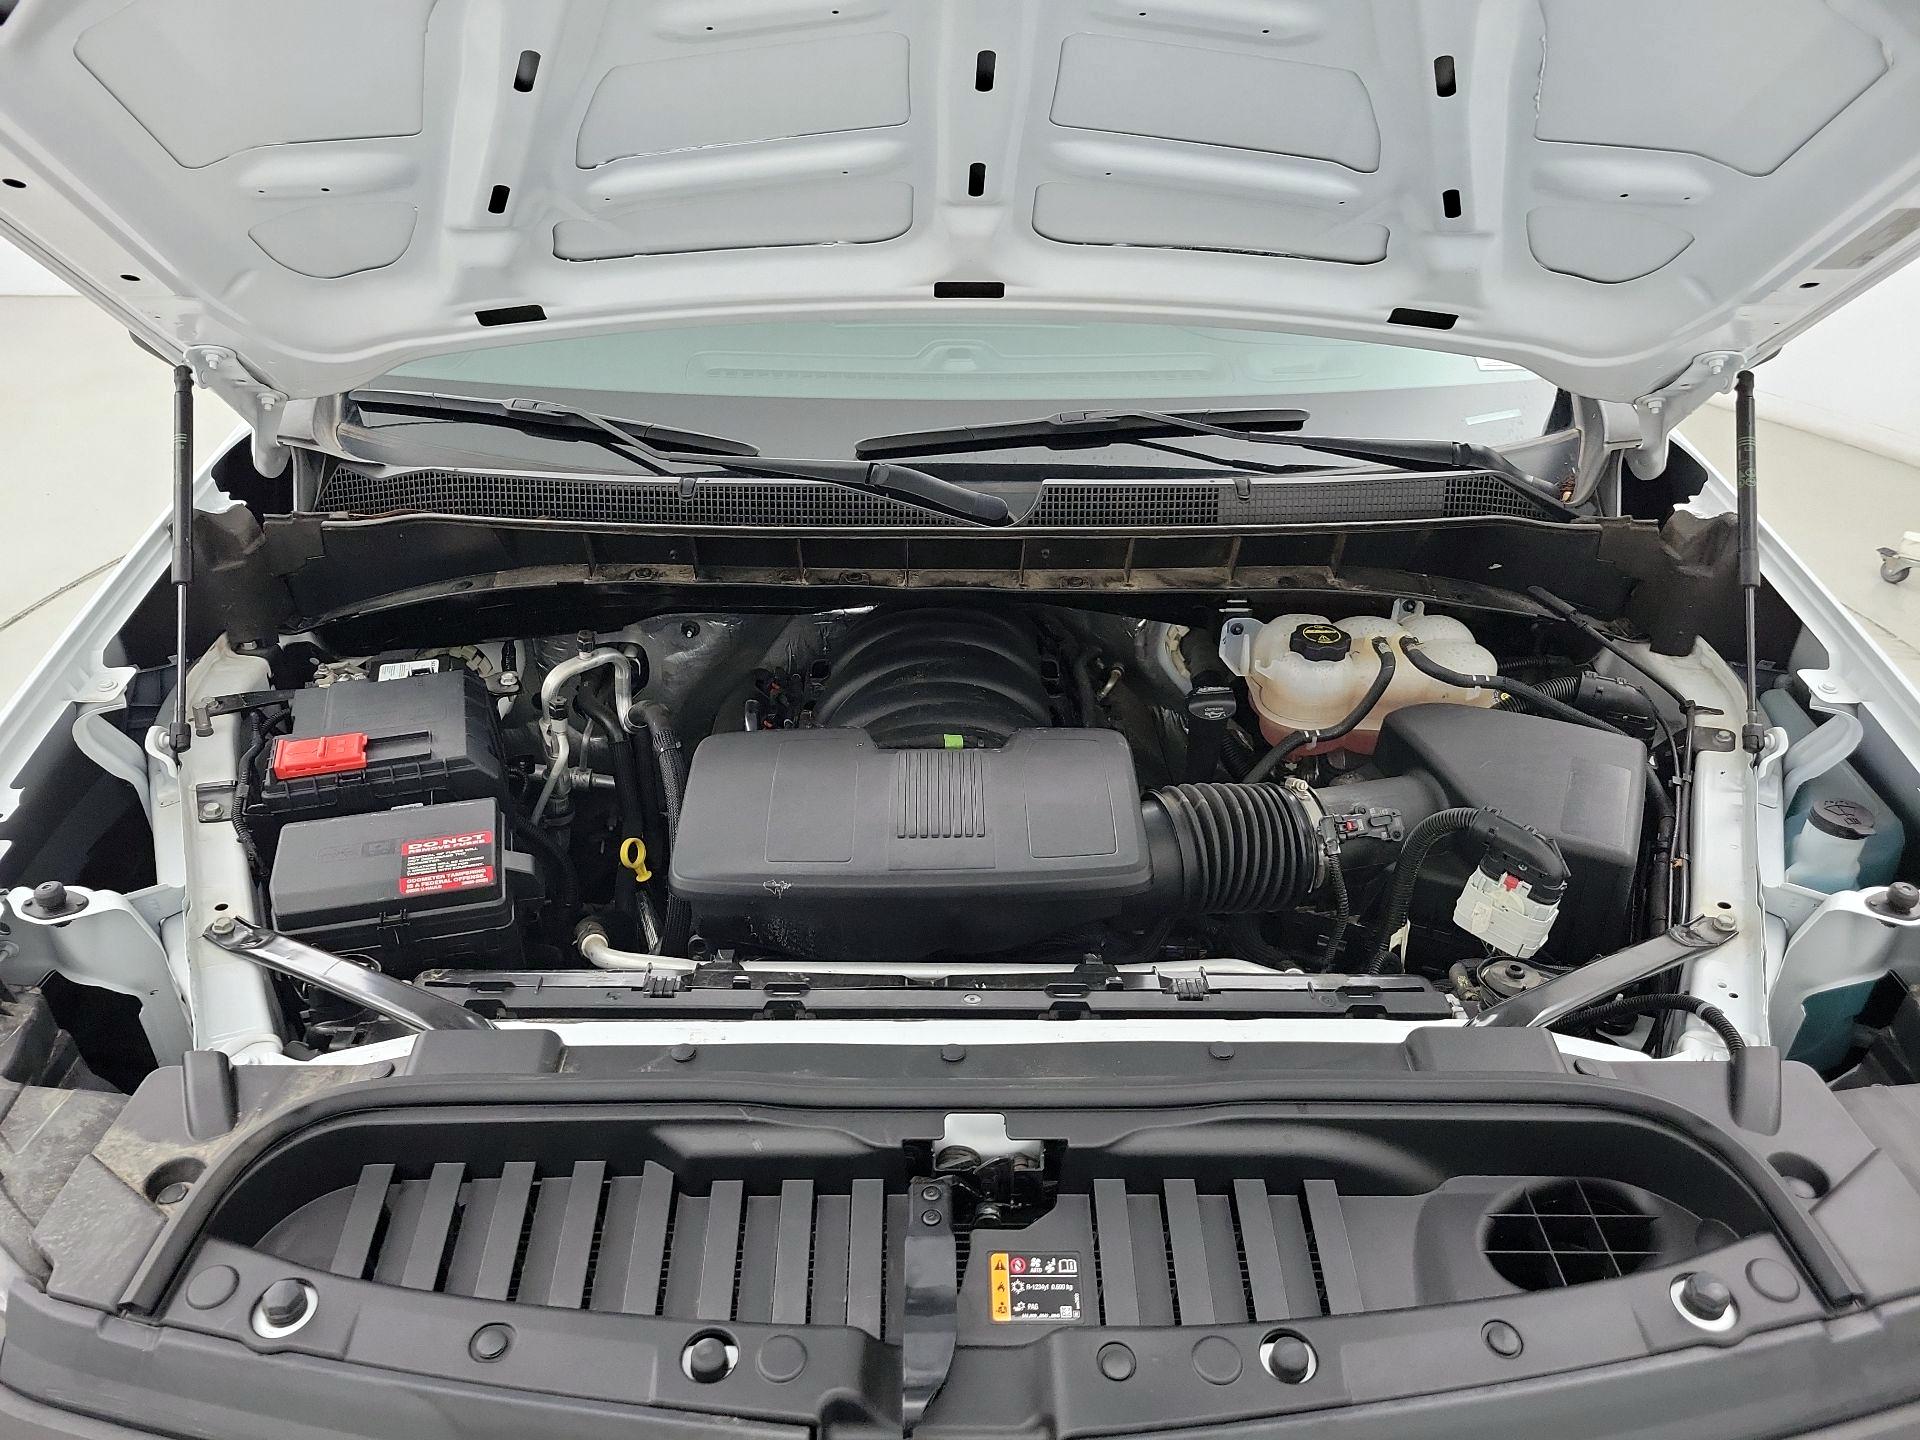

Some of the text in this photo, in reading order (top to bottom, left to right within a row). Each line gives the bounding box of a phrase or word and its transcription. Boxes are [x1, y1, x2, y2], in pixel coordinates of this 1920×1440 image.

[408, 834, 485, 850] DO NOT
[409, 845, 450, 854] REMOVE
[407, 869, 486, 884] ODOMETER TAMPERING
[421, 879, 452, 887] FEDERAL
